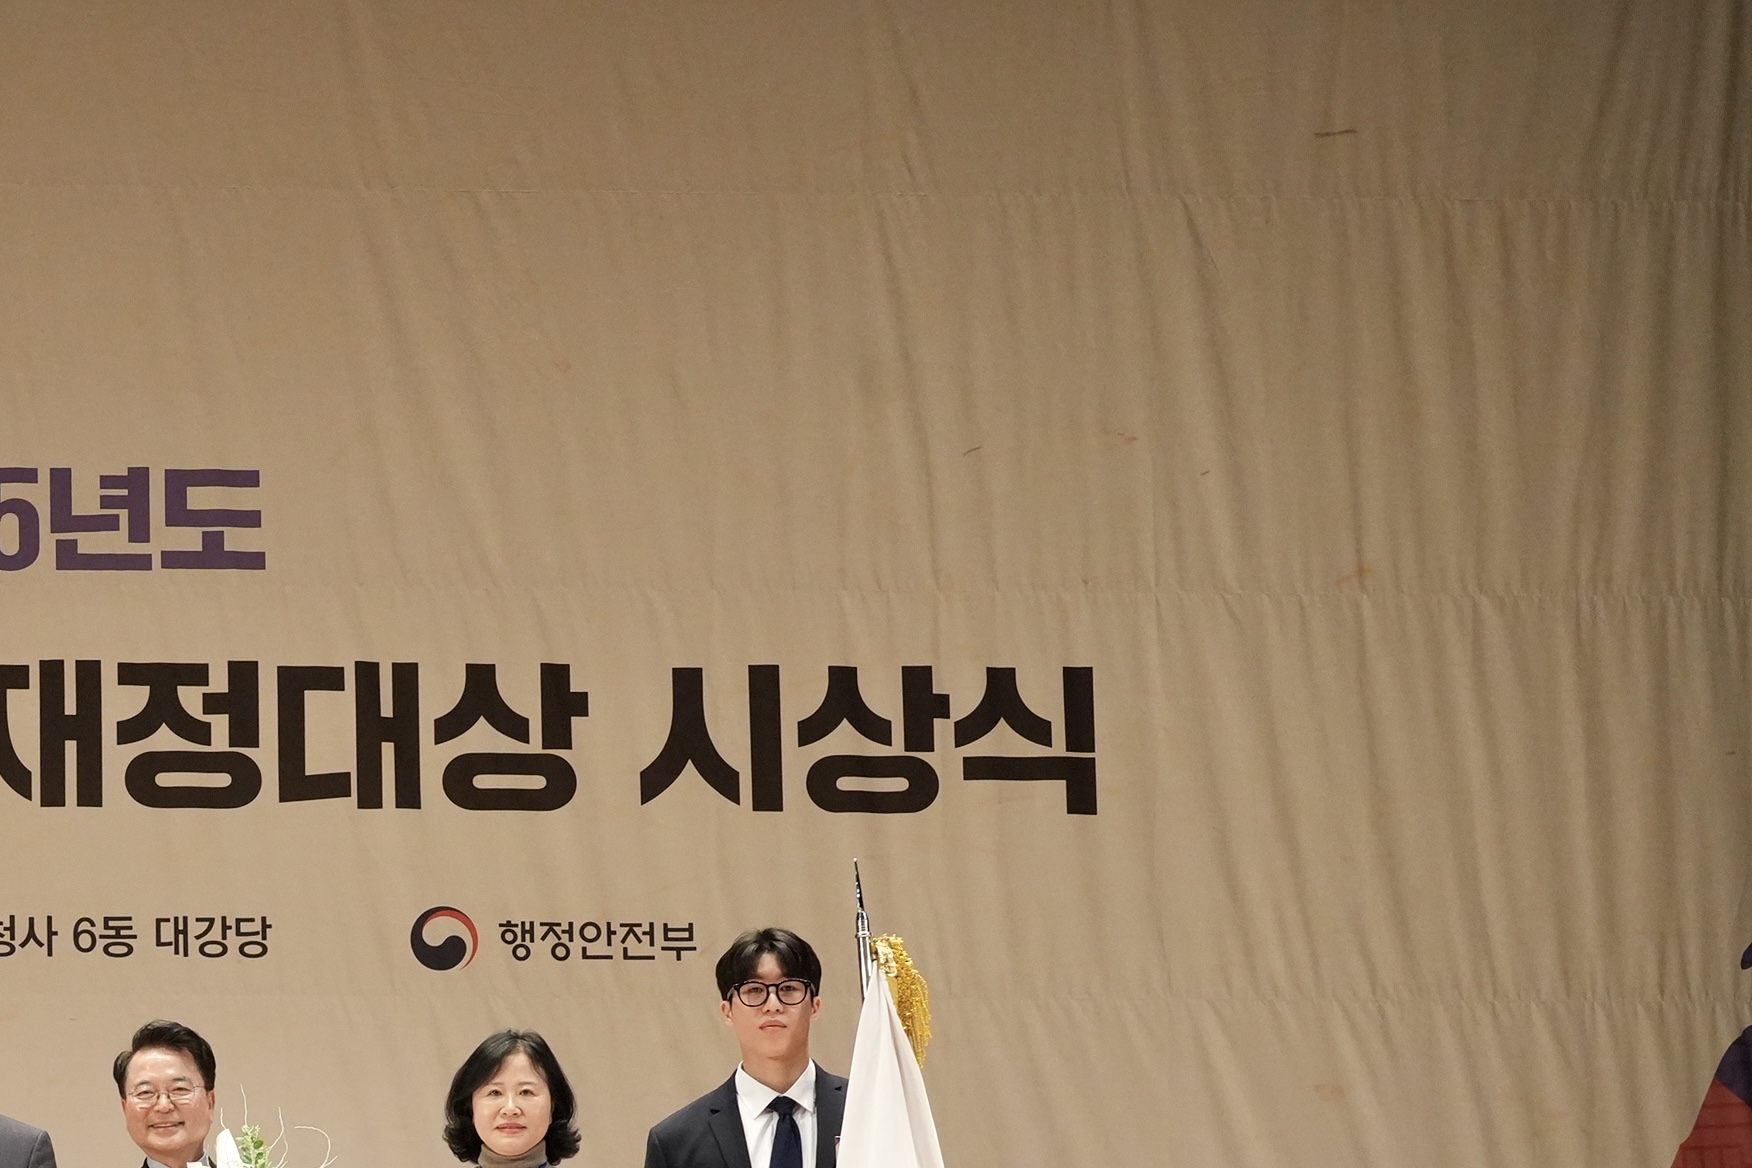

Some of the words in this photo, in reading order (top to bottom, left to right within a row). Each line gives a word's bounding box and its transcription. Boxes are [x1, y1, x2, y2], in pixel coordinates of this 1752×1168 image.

[639, 664, 1098, 816] 시상식
[71, 914, 138, 959] 6동
[155, 914, 273, 960] 대강당
[498, 919, 697, 963] 행정안전부
